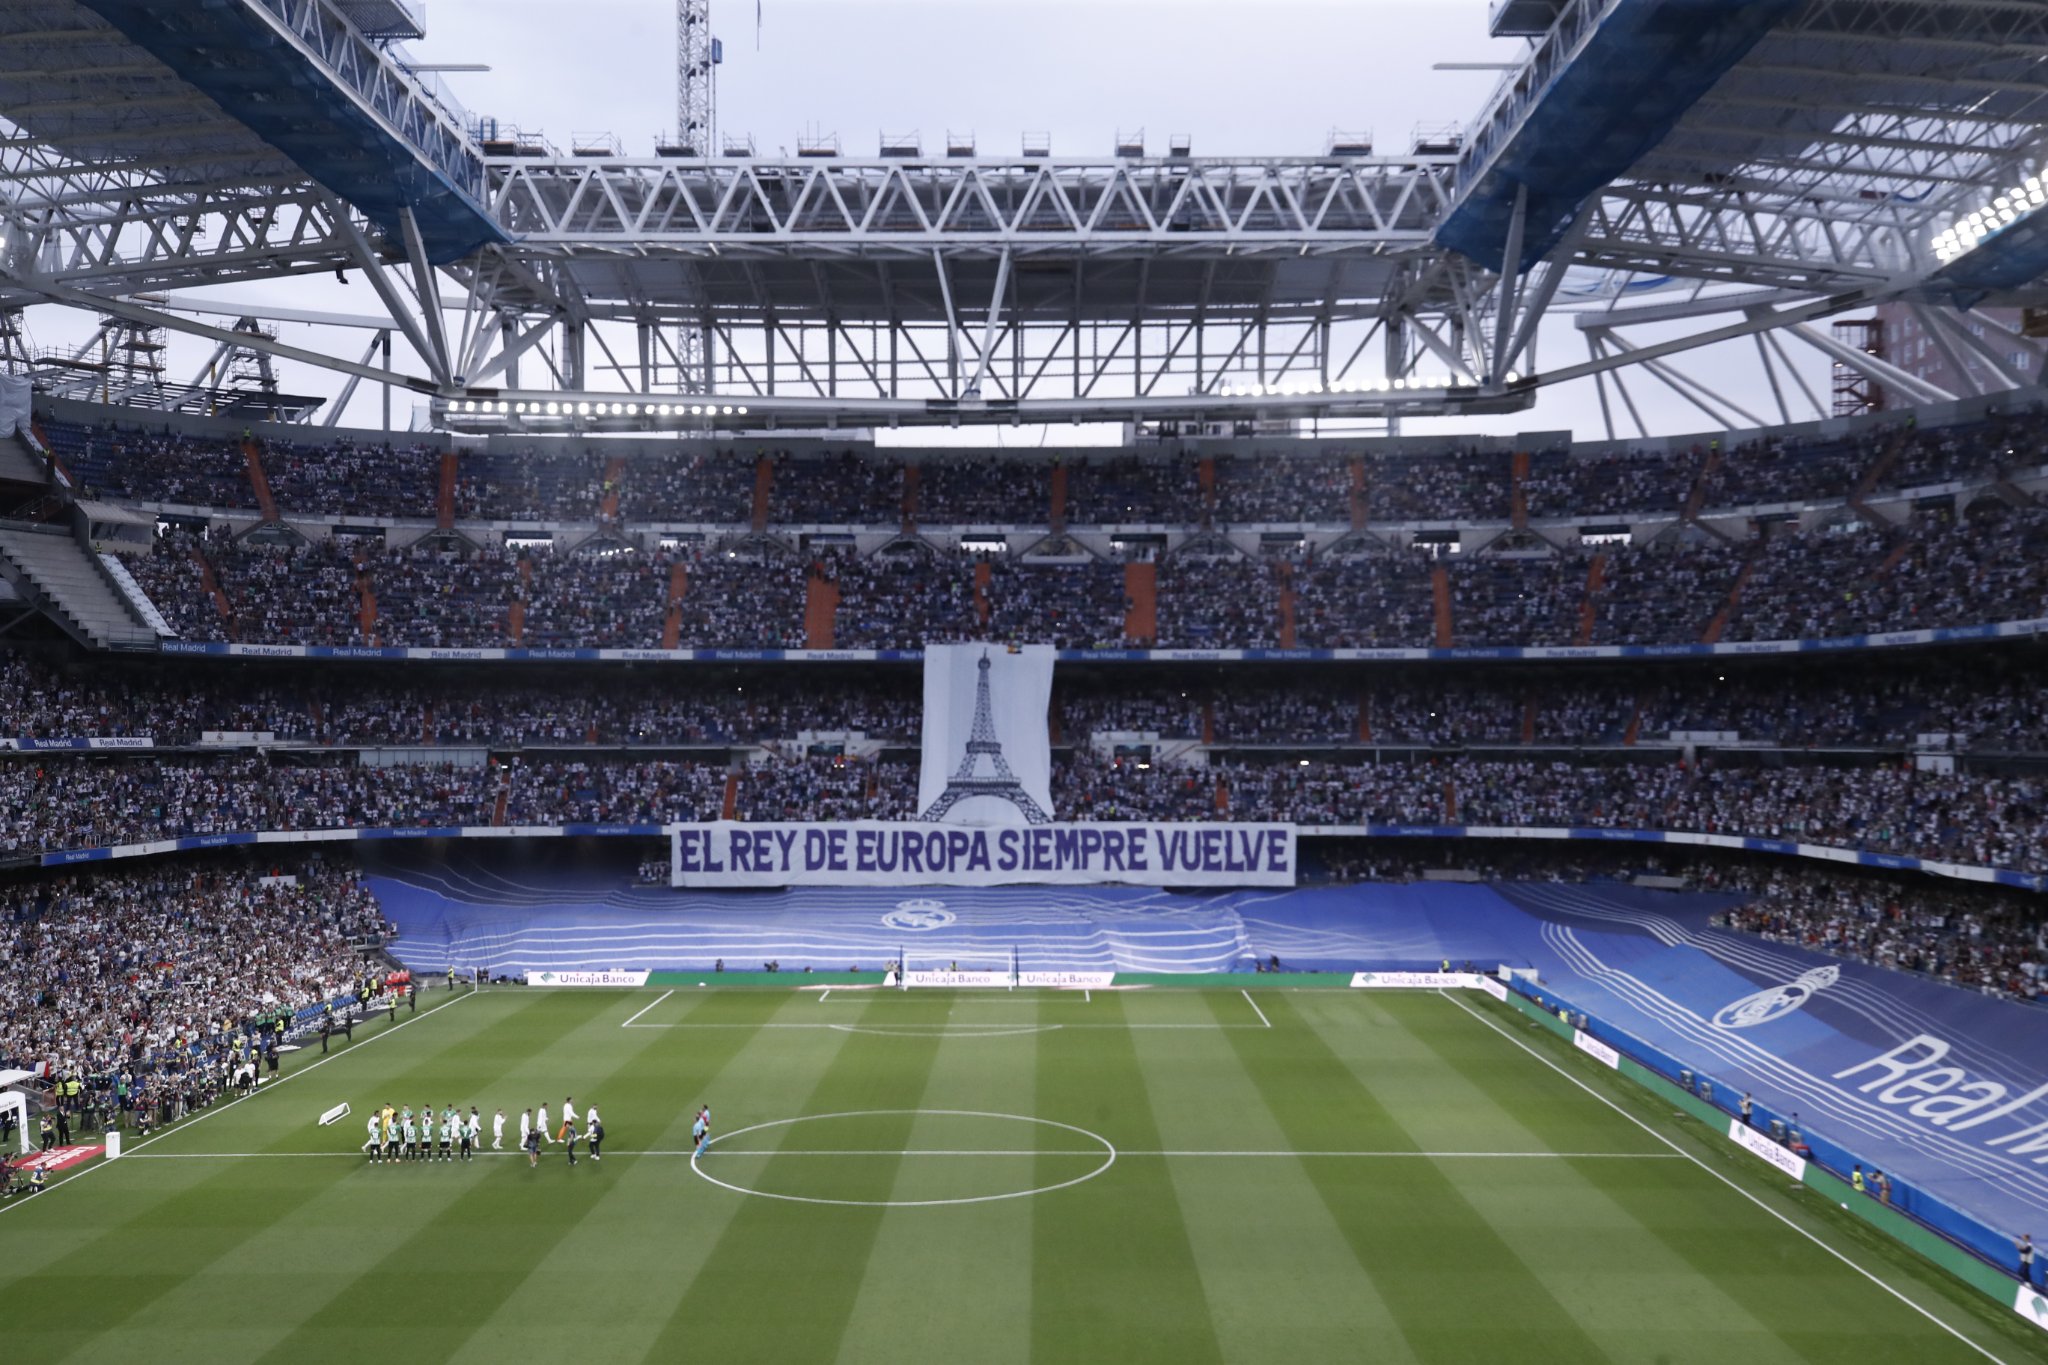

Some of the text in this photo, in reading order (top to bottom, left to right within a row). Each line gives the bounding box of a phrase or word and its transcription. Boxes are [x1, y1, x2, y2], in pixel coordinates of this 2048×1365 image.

[162, 642, 206, 653] Real Madrid
[242, 647, 292, 656] Real Madrid
[333, 649, 382, 657] Real Madrid
[431, 650, 482, 659] Real Madrid
[528, 650, 576, 658] Real Madrid
[622, 651, 671, 659] Real Madrid
[716, 650, 762, 659] Real Madrid
[807, 652, 854, 660] Real Madrid
[900, 651, 917, 659] Real
[1081, 650, 1127, 659] Real Madrid
[1172, 652, 1220, 660] Real Madrid
[1265, 650, 1311, 659] Real Madrid
[1356, 651, 1405, 659] Real Madrid
[34, 739, 73, 748] Real Madrid
[99, 739, 114, 748] Real
[680, 828, 1288, 873] EL REY DE EUROPA SIEMPRE VUELVE
[560, 973, 635, 985] Unicaja Banco
[915, 974, 991, 986] Unicaja Banco
[1026, 974, 1102, 986] Unicaja Banco
[1381, 974, 1457, 986] Unicaja Banco
[1831, 1034, 2048, 1132] Real
[1749, 1132, 1796, 1172] Unicaja Banco
